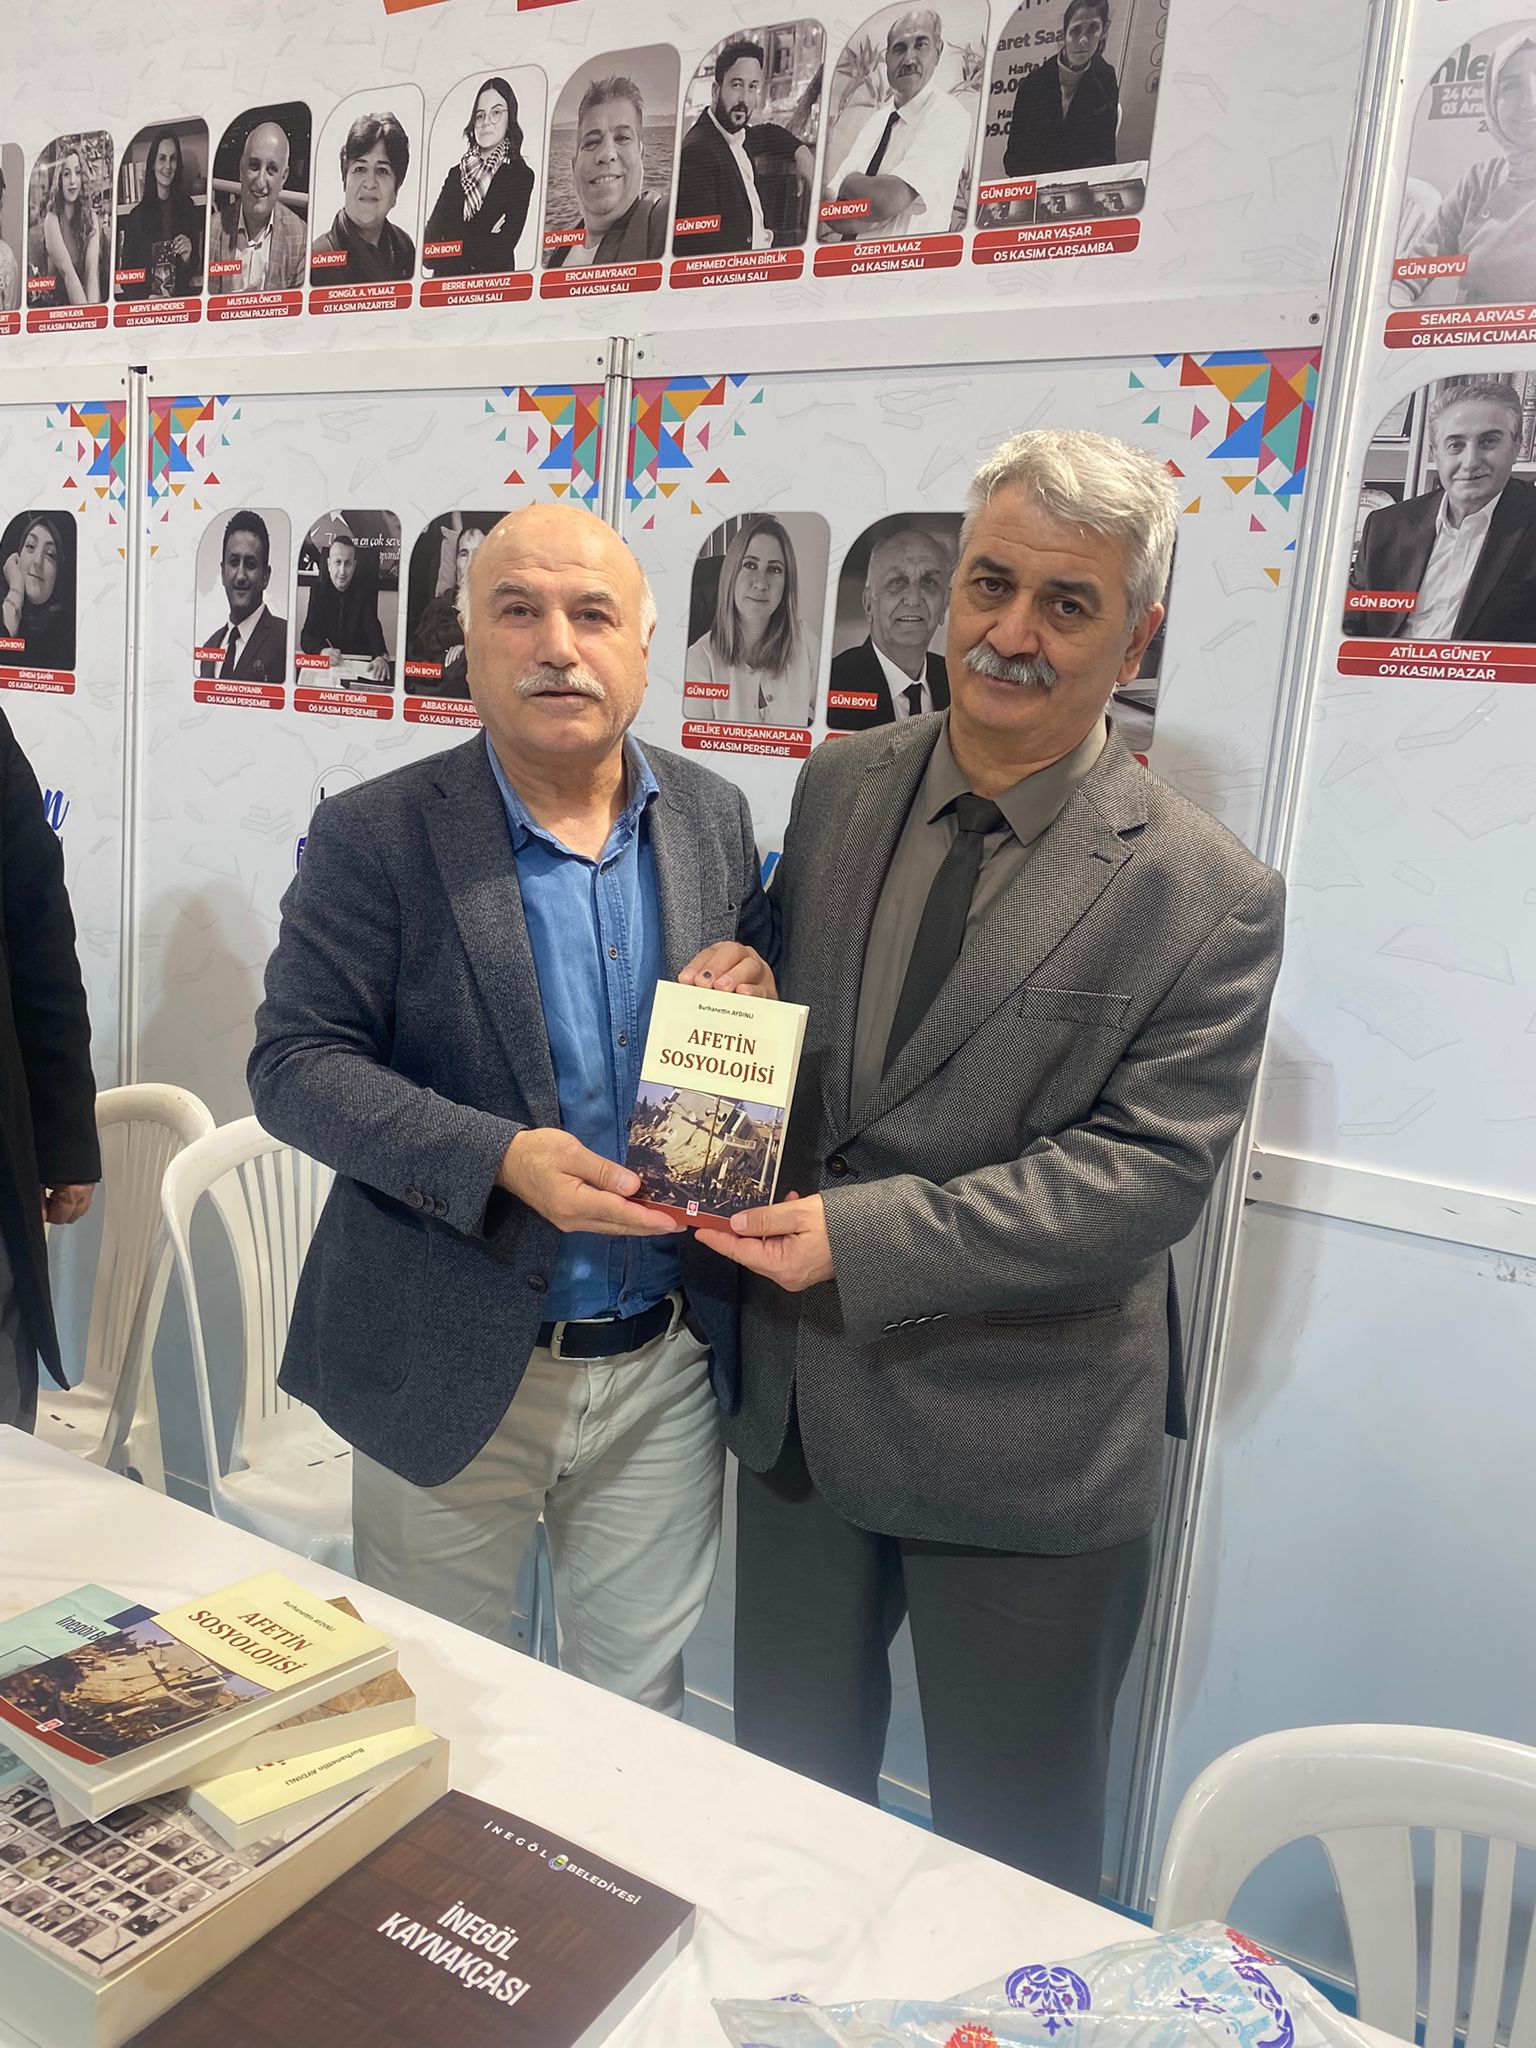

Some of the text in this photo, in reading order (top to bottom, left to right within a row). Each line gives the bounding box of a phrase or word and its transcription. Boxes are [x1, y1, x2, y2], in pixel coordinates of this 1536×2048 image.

[981, 186, 1032, 200] GÜN BOYU
[821, 204, 867, 216] GÜN BOYU
[676, 219, 718, 231] GÜN BOYU
[546, 234, 584, 244] GÜN BOYU
[1018, 226, 1092, 242] PINAR YAŞAR
[425, 245, 460, 254] GÜN BOYU
[854, 241, 921, 256] ÖZER YILMAZ
[993, 242, 1114, 262] 05 KASIM ÇARŞAMBA
[313, 255, 345, 264] GÜN BOYU
[686, 251, 787, 271] MEHMED CİHAN BİRLİK
[851, 258, 924, 272] 04 KASIM SALI
[224, 264, 240, 272] BOYU
[1398, 262, 1466, 276] GÜN BOYU
[565, 272, 594, 281] ERCAN
[702, 271, 768, 285] 04 KASIM SALI
[442, 278, 510, 291] BERRE NUR YAVUZ
[570, 283, 629, 295] 04 KASIM SALI
[328, 288, 357, 299] SONGÜL
[368, 287, 395, 296] YILMAZ
[448, 293, 503, 304] 04 KASIM SALI
[227, 297, 258, 306] MUSTAFA
[333, 302, 356, 312] KASIM
[357, 298, 397, 310] PAZARTESİ
[230, 310, 251, 318] KASIM
[1420, 312, 1472, 325] SEMRA
[1475, 309, 1525, 322] ARVAS
[135, 317, 154, 325] KASIM
[1412, 334, 1430, 345] 08
[1433, 332, 1480, 344] KASIM
[1350, 596, 1415, 609] GÜN BOYU
[1390, 644, 1492, 661] ATİLLA GÜNEY
[406, 666, 421, 674] GÜN
[1379, 664, 1496, 680] 09 KASIM PAZAR
[320, 693, 344, 701] AHMET
[687, 686, 729, 697] GÜN BOYU
[216, 697, 236, 705] KASIM
[421, 701, 446, 710] ABBAS
[831, 694, 876, 707] GÜN BOYU
[318, 705, 340, 714] KASIM
[419, 714, 429, 722] 06
[430, 715, 454, 724] KASIM
[689, 723, 803, 741] MELİKE VURUŞANKAPLAN
[700, 740, 790, 756] 06 KASIM PERŞEMBE
[687, 1028, 756, 1055] AFETİN
[660, 1048, 775, 1085] SOSYOLOJİSİ
[237, 1612, 313, 1652] AFETİN
[188, 1609, 308, 1675] SOSYOLOJİSİ
[484, 1821, 642, 1905] İNEGÖL BELEDİYESİ
[437, 1900, 519, 1961] İNEGÖL
[377, 1912, 531, 2006] KAYNAKÇASI
